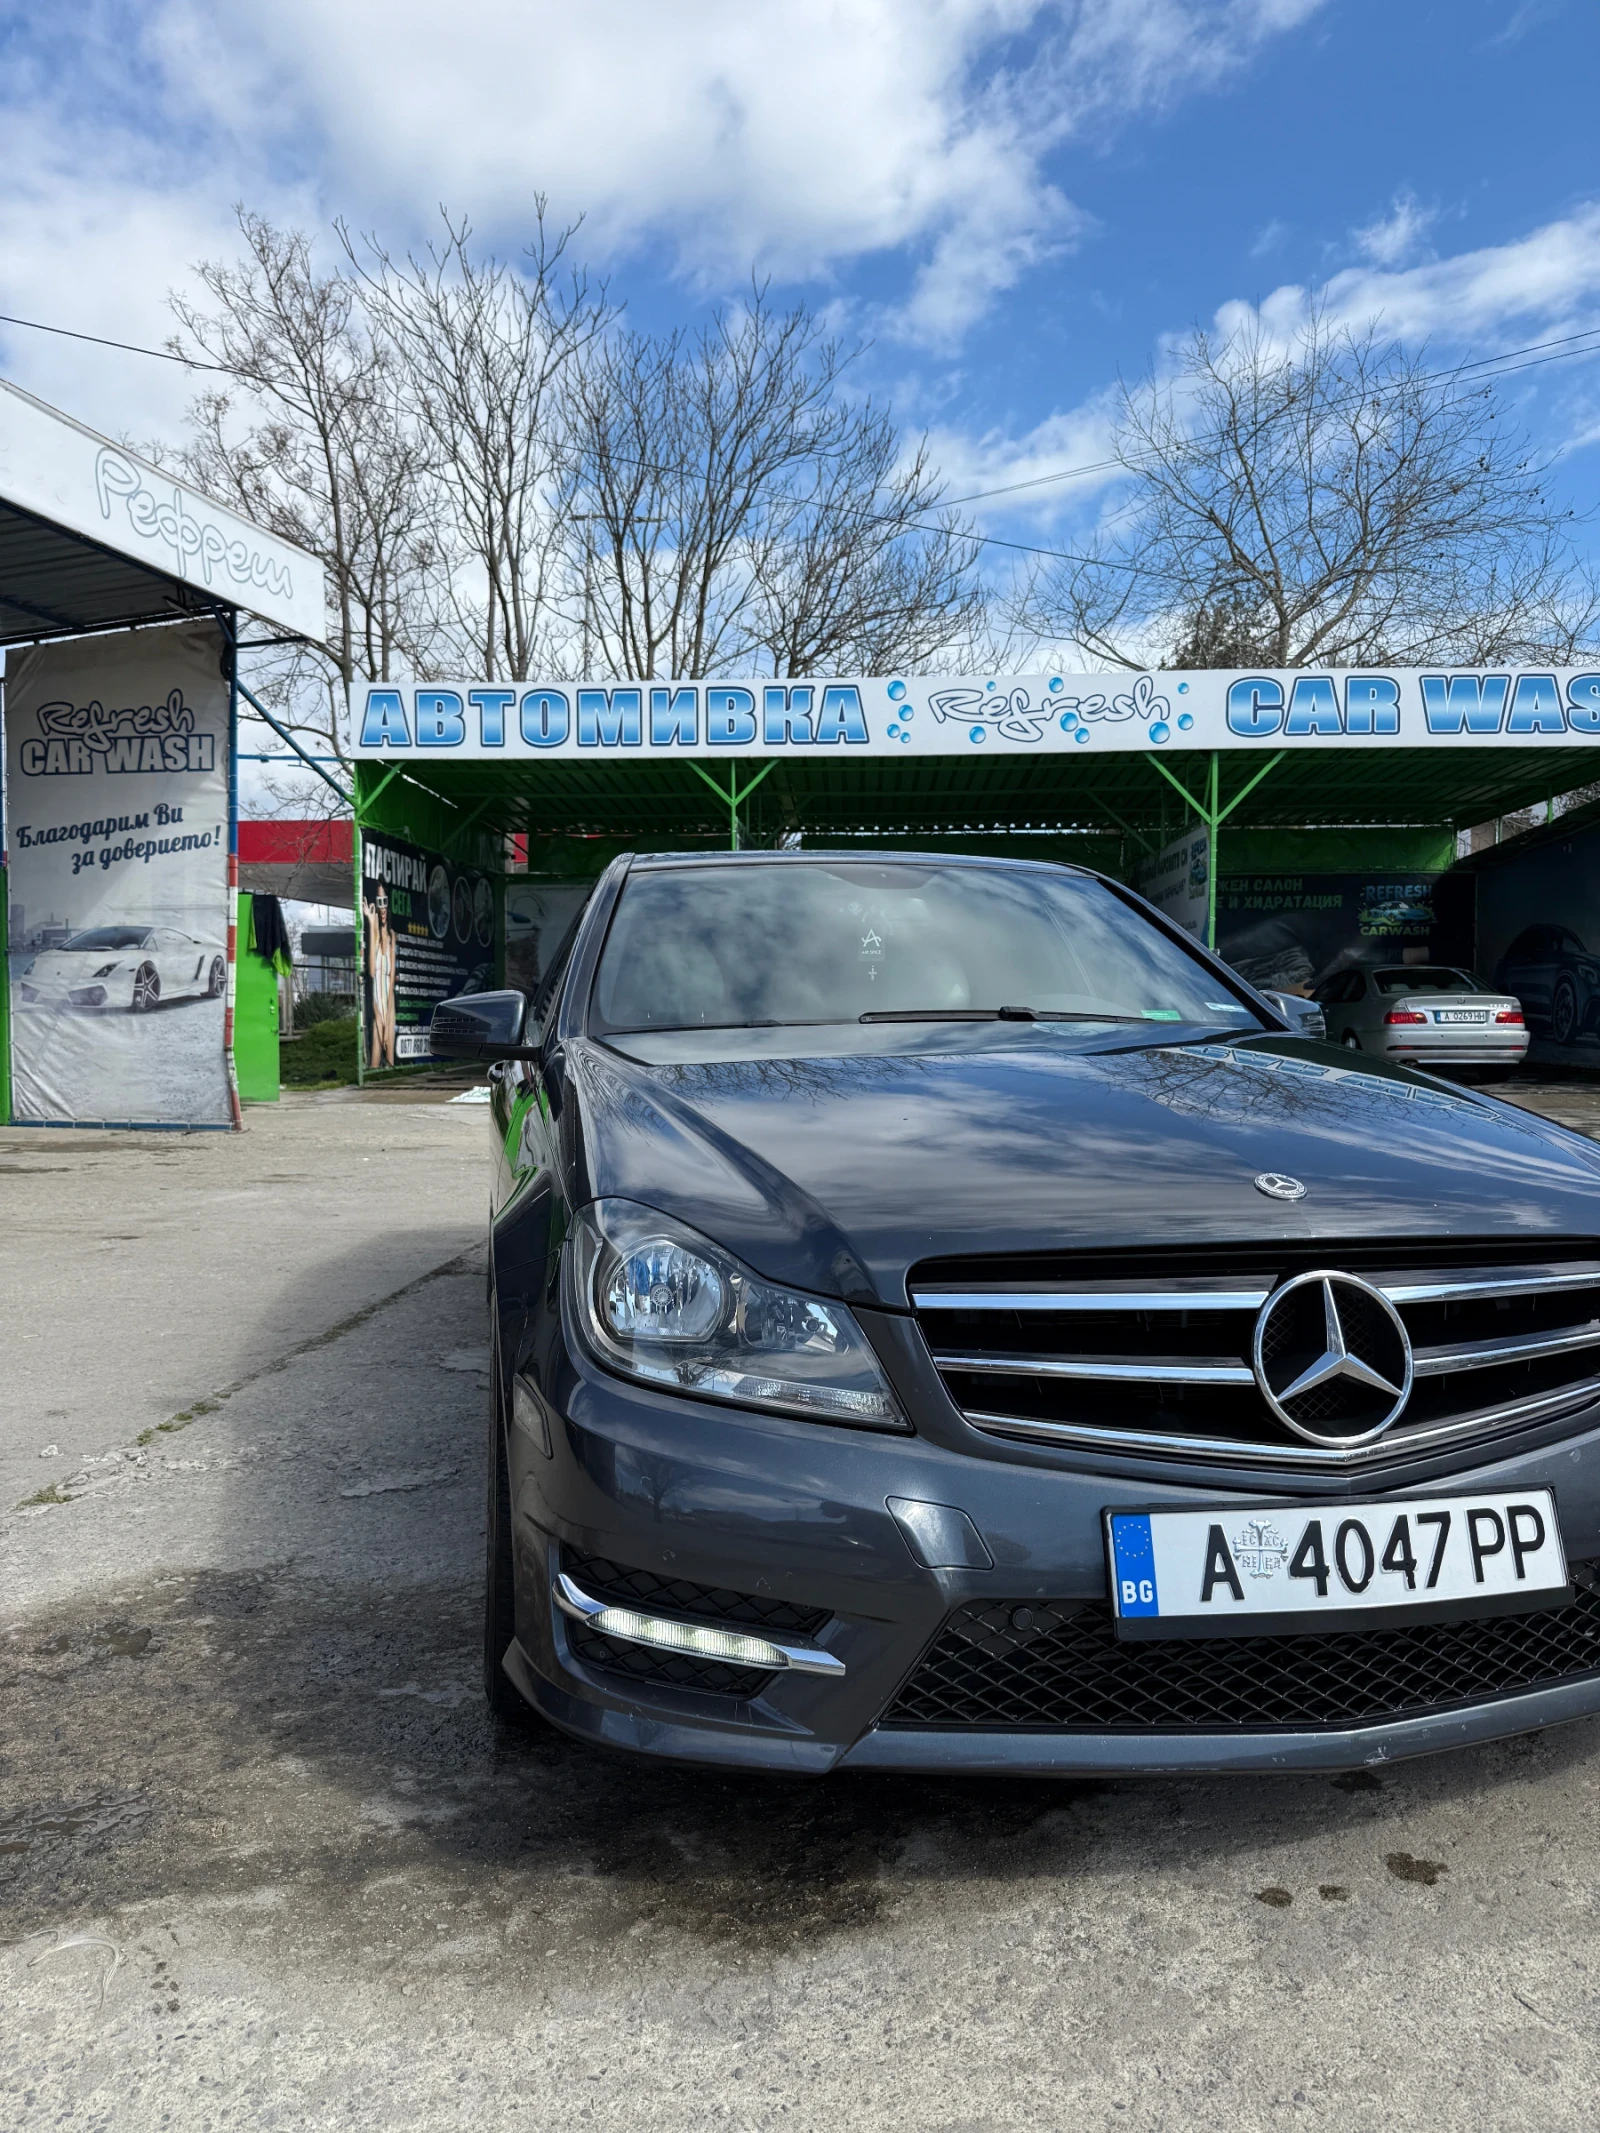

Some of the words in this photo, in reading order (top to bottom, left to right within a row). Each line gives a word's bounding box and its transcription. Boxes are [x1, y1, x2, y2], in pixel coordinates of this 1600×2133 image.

[37, 688, 195, 753] Refresh
[360, 686, 870, 749] АВТОМИВКА
[929, 676, 1172, 743] Refresh
[1226, 675, 1401, 736] CAR
[21, 737, 93, 776] CAR
[104, 734, 215, 774] WASH
[16, 812, 149, 848] Благодарим
[154, 803, 183, 826] Ви
[71, 853, 95, 875] за
[99, 825, 221, 870] доверието!
[1243, 895, 1343, 911] ХИДРАТАЦИЯ
[1253, 878, 1304, 892] САЛОН
[1365, 884, 1433, 901] REFRESH
[1360, 926, 1431, 936] CARWASH
[1453, 1011, 1473, 1020] 0269
[1200, 1523, 1246, 1602] A
[1288, 1510, 1452, 1597] 4047
[1464, 1503, 1546, 1584] PP
[1121, 1580, 1154, 1604] BG
